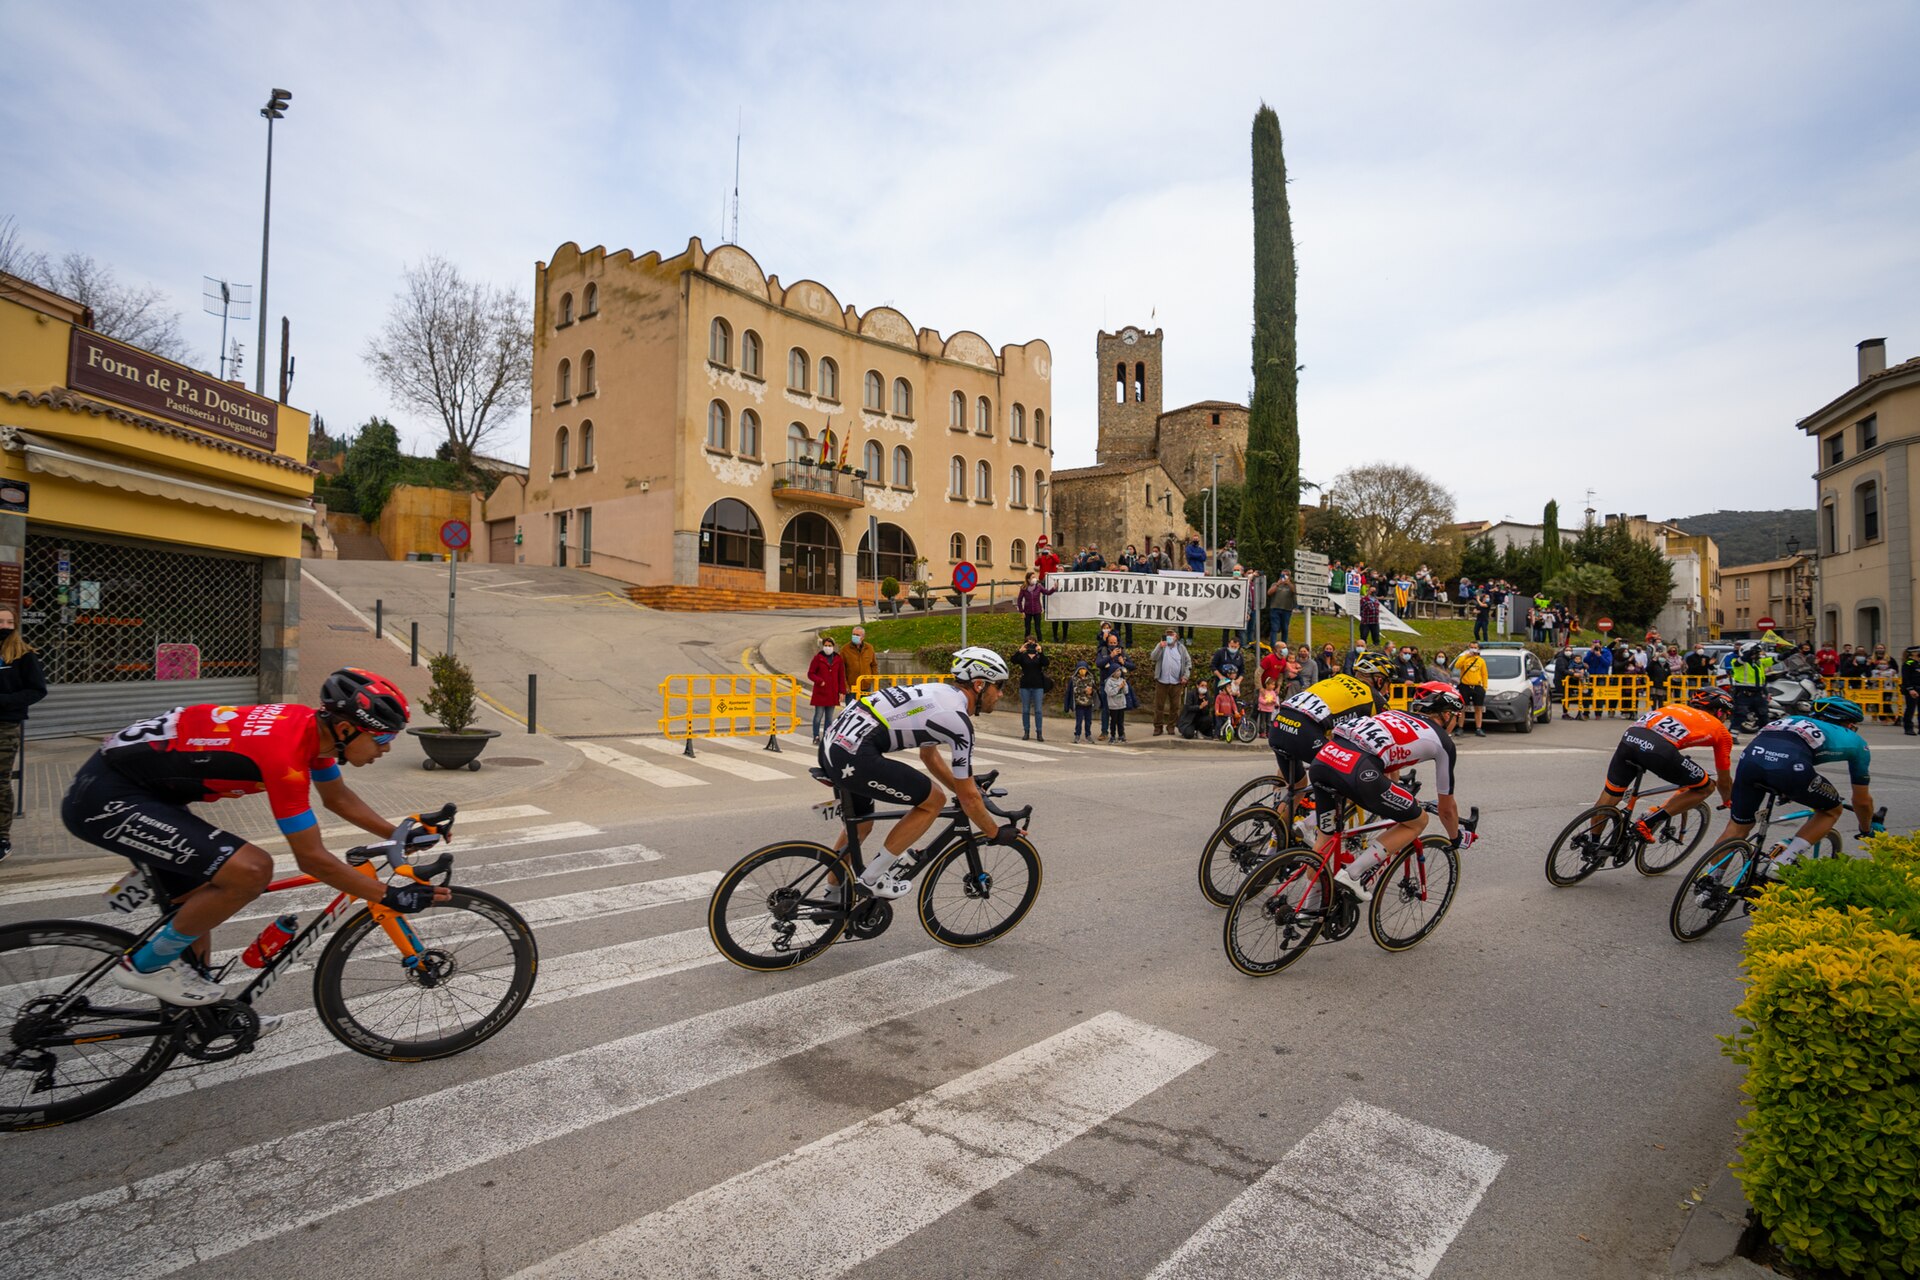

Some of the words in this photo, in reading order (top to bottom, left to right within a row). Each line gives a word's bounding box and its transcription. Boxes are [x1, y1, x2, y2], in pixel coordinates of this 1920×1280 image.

[87, 345, 140, 383] Forn
[145, 368, 171, 393] de
[175, 377, 200, 404] Pa
[204, 387, 269, 427] Dosrius
[166, 397, 215, 423] Pastisseria
[217, 413, 221, 425] i
[222, 415, 268, 440] Degustació
[1054, 577, 1158, 595] LLIBERTAT
[1163, 581, 1241, 599] PRESOS
[1098, 600, 1188, 622] POLÍTICS
[1308, 700, 1326, 715] 14
[252, 703, 287, 736] HRAIN
[356, 709, 389, 729] RUDY
[840, 712, 872, 743] 174
[1276, 714, 1302, 728] JUMBO
[1279, 722, 1298, 735] VISMA
[1658, 715, 1687, 738] 241
[1357, 721, 1390, 749] 144
[1803, 720, 1822, 739] 76
[186, 737, 232, 746] MERIDA
[1324, 744, 1354, 762] CAPS
[1389, 746, 1412, 763] lotto
[1765, 750, 1790, 760] PREMIER
[1384, 790, 1412, 808] SOUDAL
[138, 815, 178, 834] BUSINESS
[102, 812, 199, 865] friendly
[124, 838, 167, 858] BAHRAIN
[109, 885, 150, 914] 123
[250, 893, 353, 1001] MERIDA
